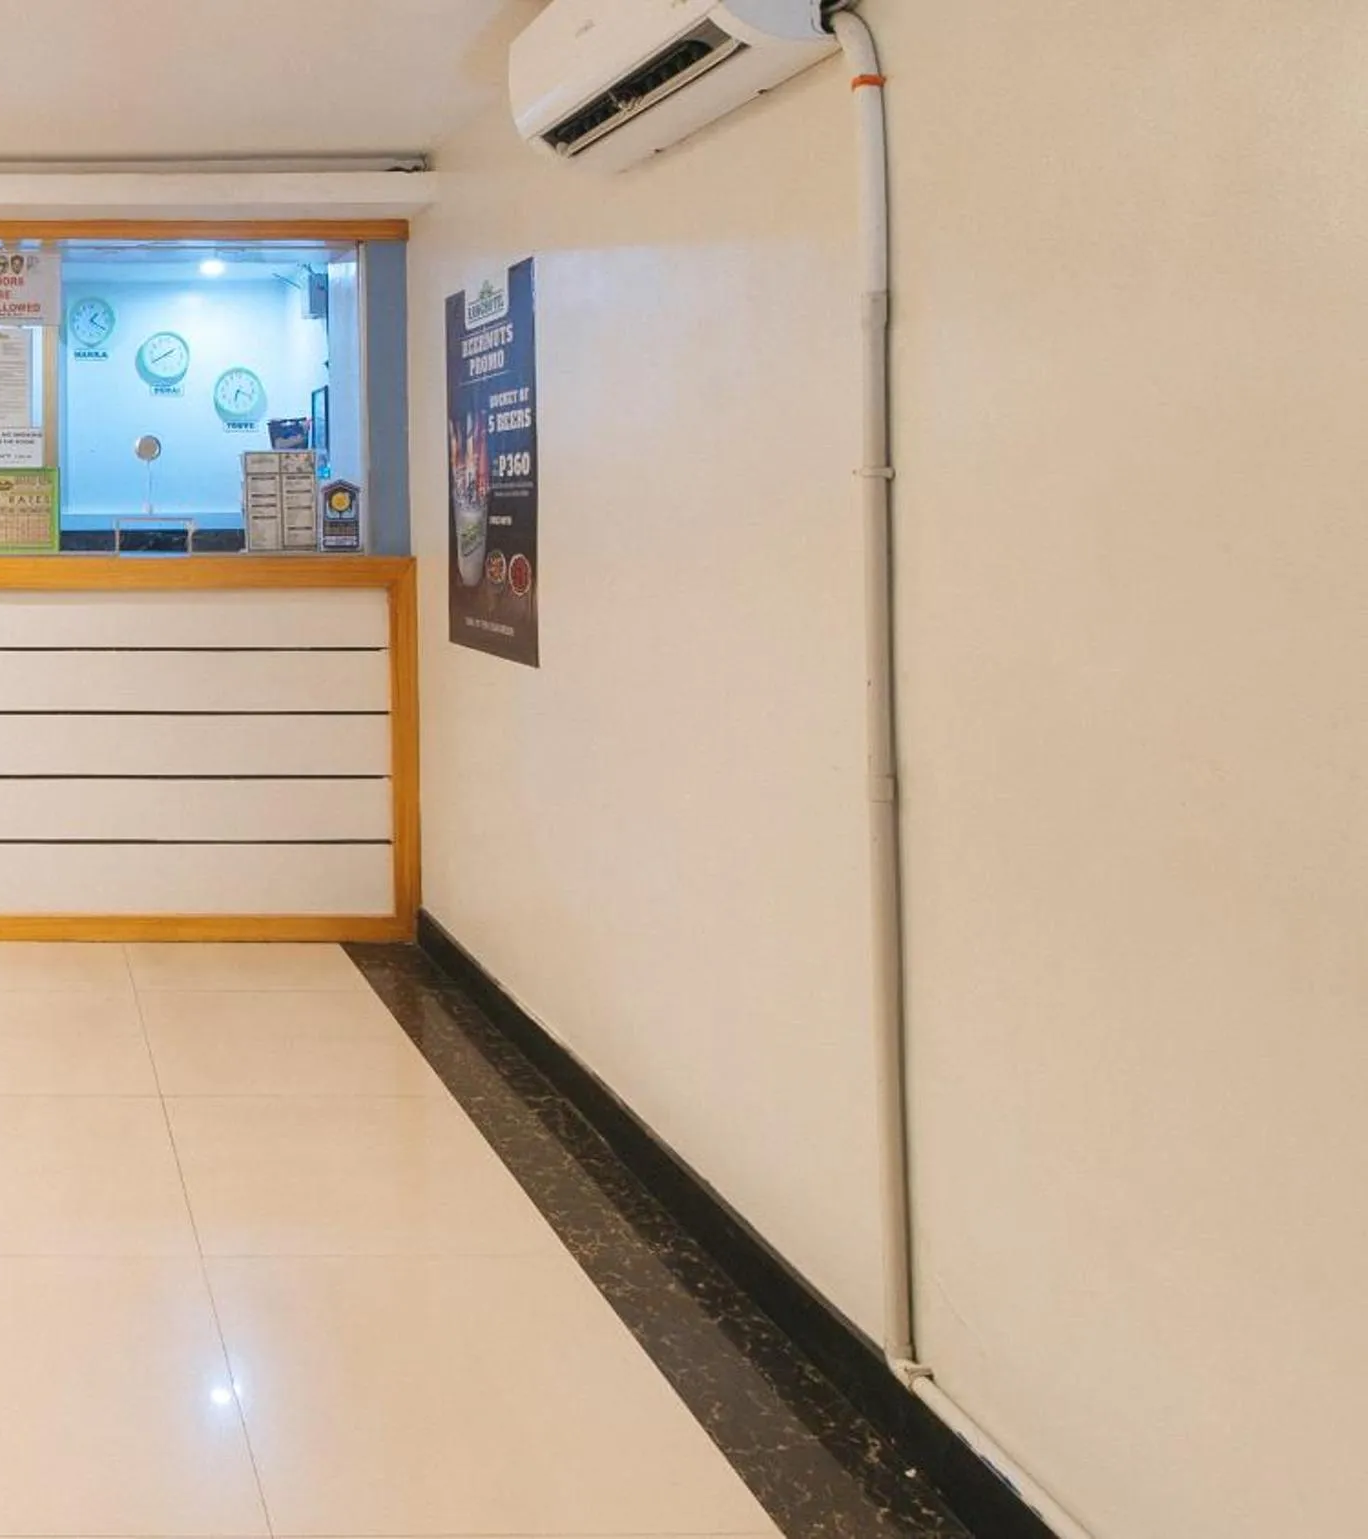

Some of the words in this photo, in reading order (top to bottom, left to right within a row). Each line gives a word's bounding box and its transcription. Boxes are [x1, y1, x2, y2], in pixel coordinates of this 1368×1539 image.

[469, 349, 504, 376] PROMO
[488, 415, 495, 433] 5
[496, 408, 532, 432] BEERS
